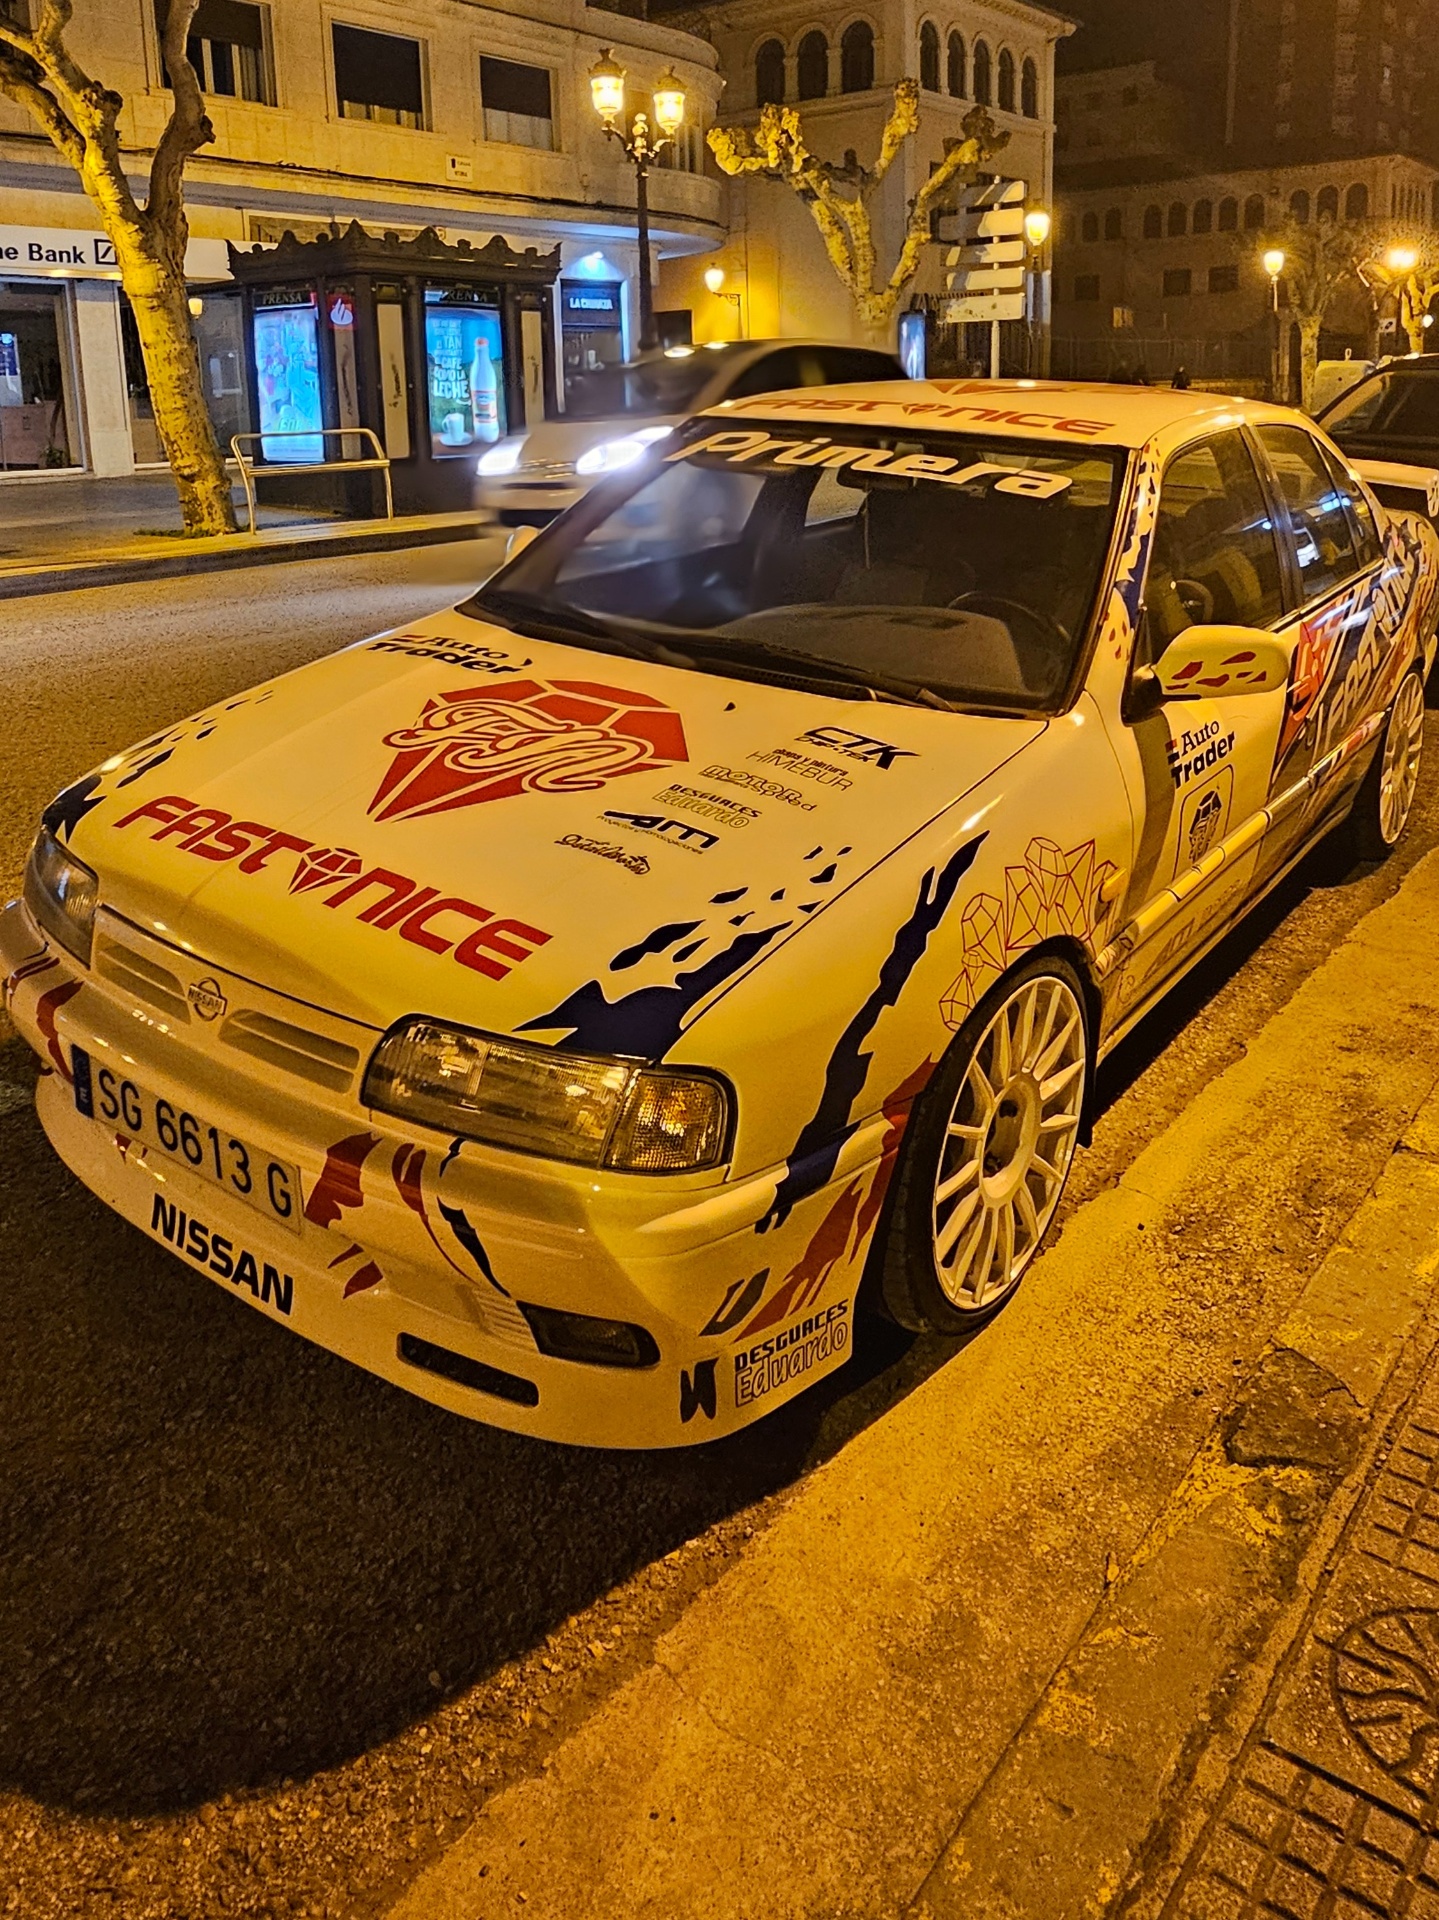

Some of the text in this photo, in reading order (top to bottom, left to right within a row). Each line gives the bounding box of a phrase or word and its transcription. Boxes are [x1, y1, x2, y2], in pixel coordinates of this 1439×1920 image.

[28, 243, 86, 264] Bank
[262, 292, 302, 304] PRENSA
[569, 297, 581, 308] LA
[433, 380, 469, 399] LECHE
[734, 398, 1116, 436] FAST NICE
[664, 430, 1074, 499] Primera
[366, 642, 523, 674] Trader
[414, 637, 510, 659] Auto
[803, 726, 922, 771] CTK
[1181, 720, 1220, 756] Auto
[746, 750, 853, 791] HIMEBUR
[1171, 731, 1235, 789] Trader
[652, 788, 750, 829] Eduardo
[668, 783, 763, 818] DESGUACES
[113, 795, 555, 982] FAST NICE
[188, 987, 223, 1011] NISSAN
[98, 1068, 293, 1218] SG 6613 G
[151, 1192, 294, 1316] NISSAN
[734, 1298, 849, 1373] DESGUACES
[734, 1321, 849, 1408] Eduardo
